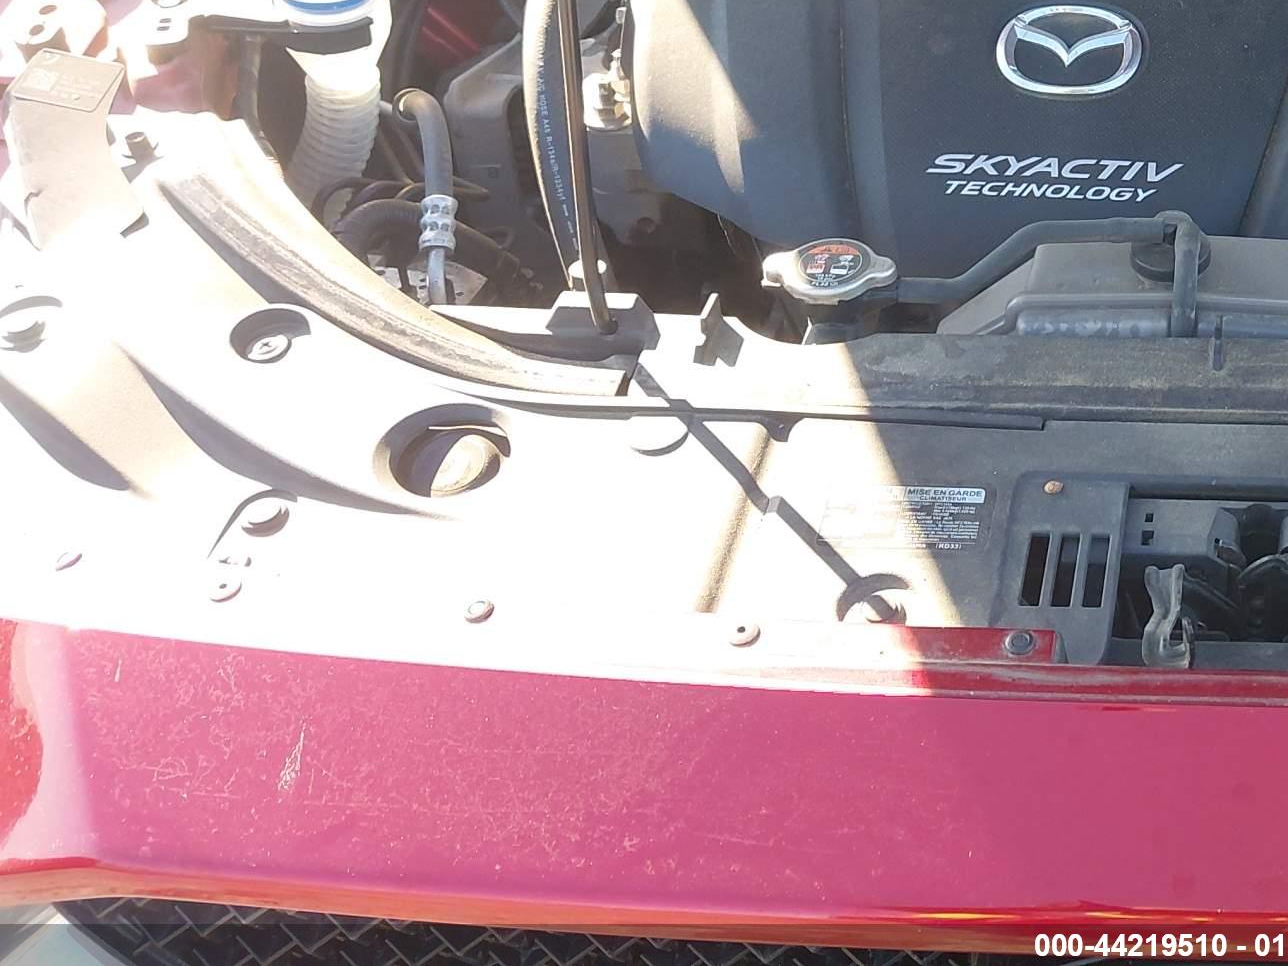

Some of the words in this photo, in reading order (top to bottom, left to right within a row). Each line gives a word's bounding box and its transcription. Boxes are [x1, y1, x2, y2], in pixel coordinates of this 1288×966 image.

[926, 153, 1184, 182] SKYACTIV
[945, 180, 1157, 202] TECHNOLOGY
[907, 488, 931, 496] MISE
[948, 489, 983, 497] GARDE
